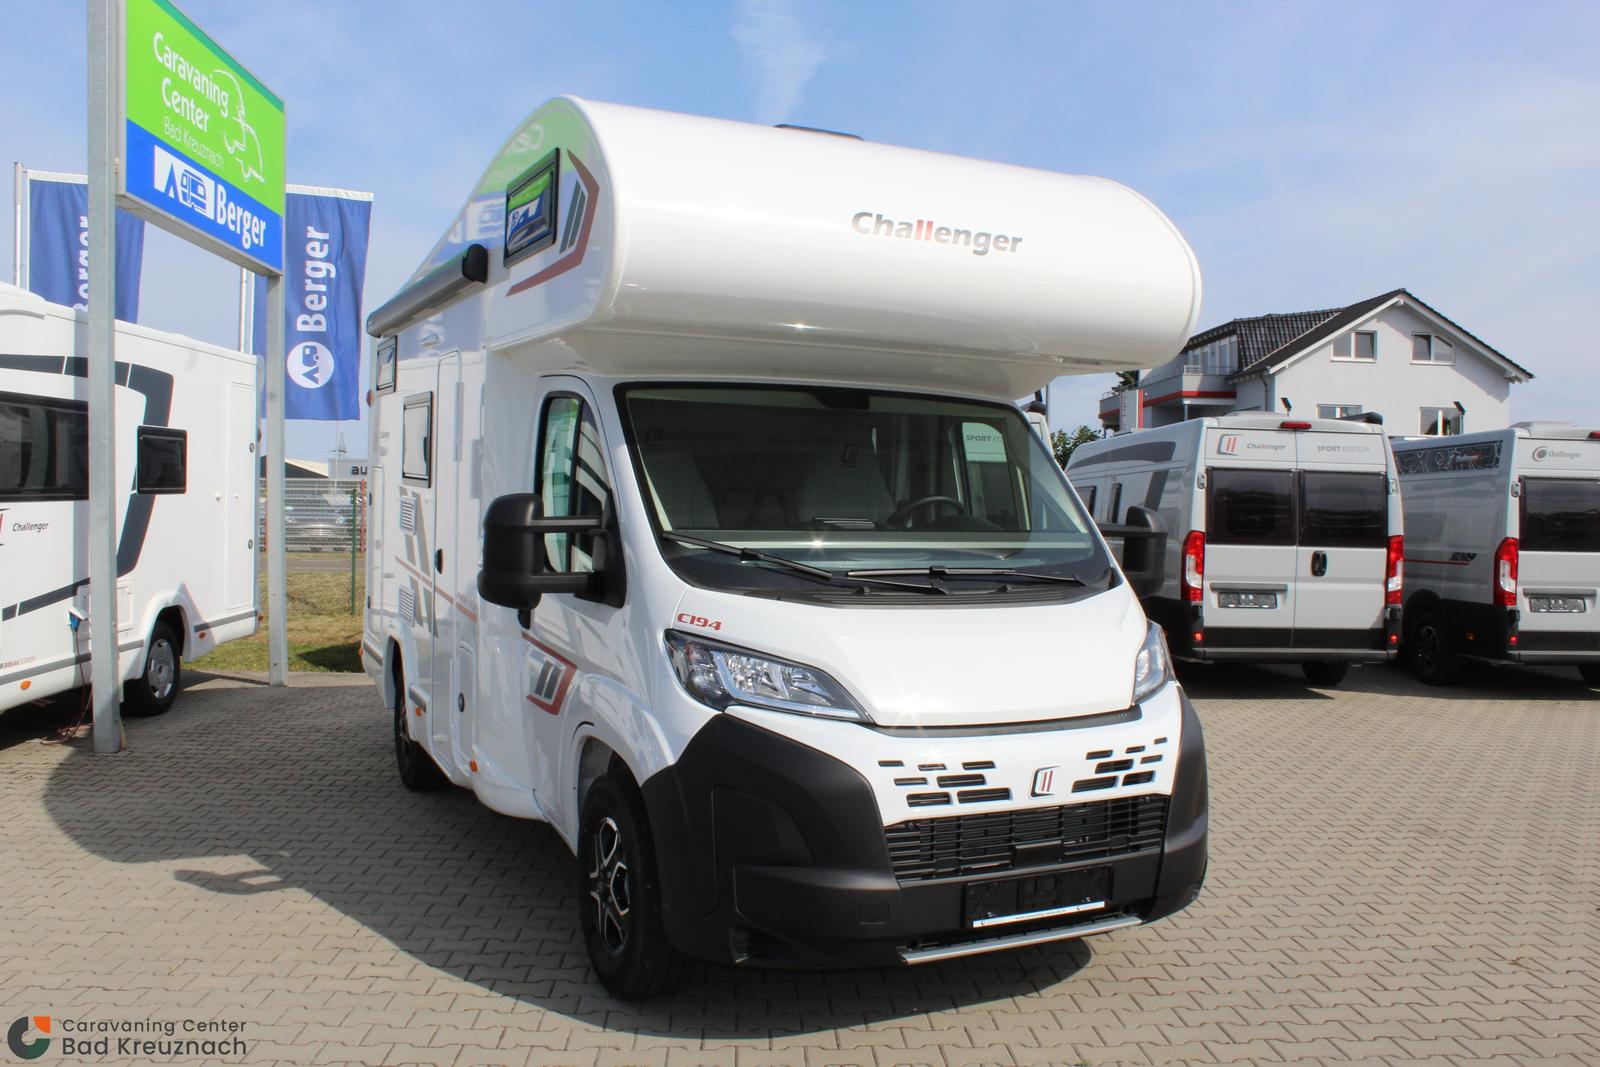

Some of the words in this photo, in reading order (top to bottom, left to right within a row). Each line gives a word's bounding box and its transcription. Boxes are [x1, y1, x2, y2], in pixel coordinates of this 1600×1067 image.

[153, 31, 229, 118] Caravaning
[161, 77, 210, 132] Center
[164, 115, 182, 142] Bad
[183, 128, 225, 172] Kreuznach
[216, 183, 266, 250] Berger
[851, 211, 1023, 256] Challenger
[296, 226, 337, 332] Berger
[1246, 441, 1286, 452] Challenger
[12, 521, 49, 533] Challenger
[677, 612, 722, 631] C194
